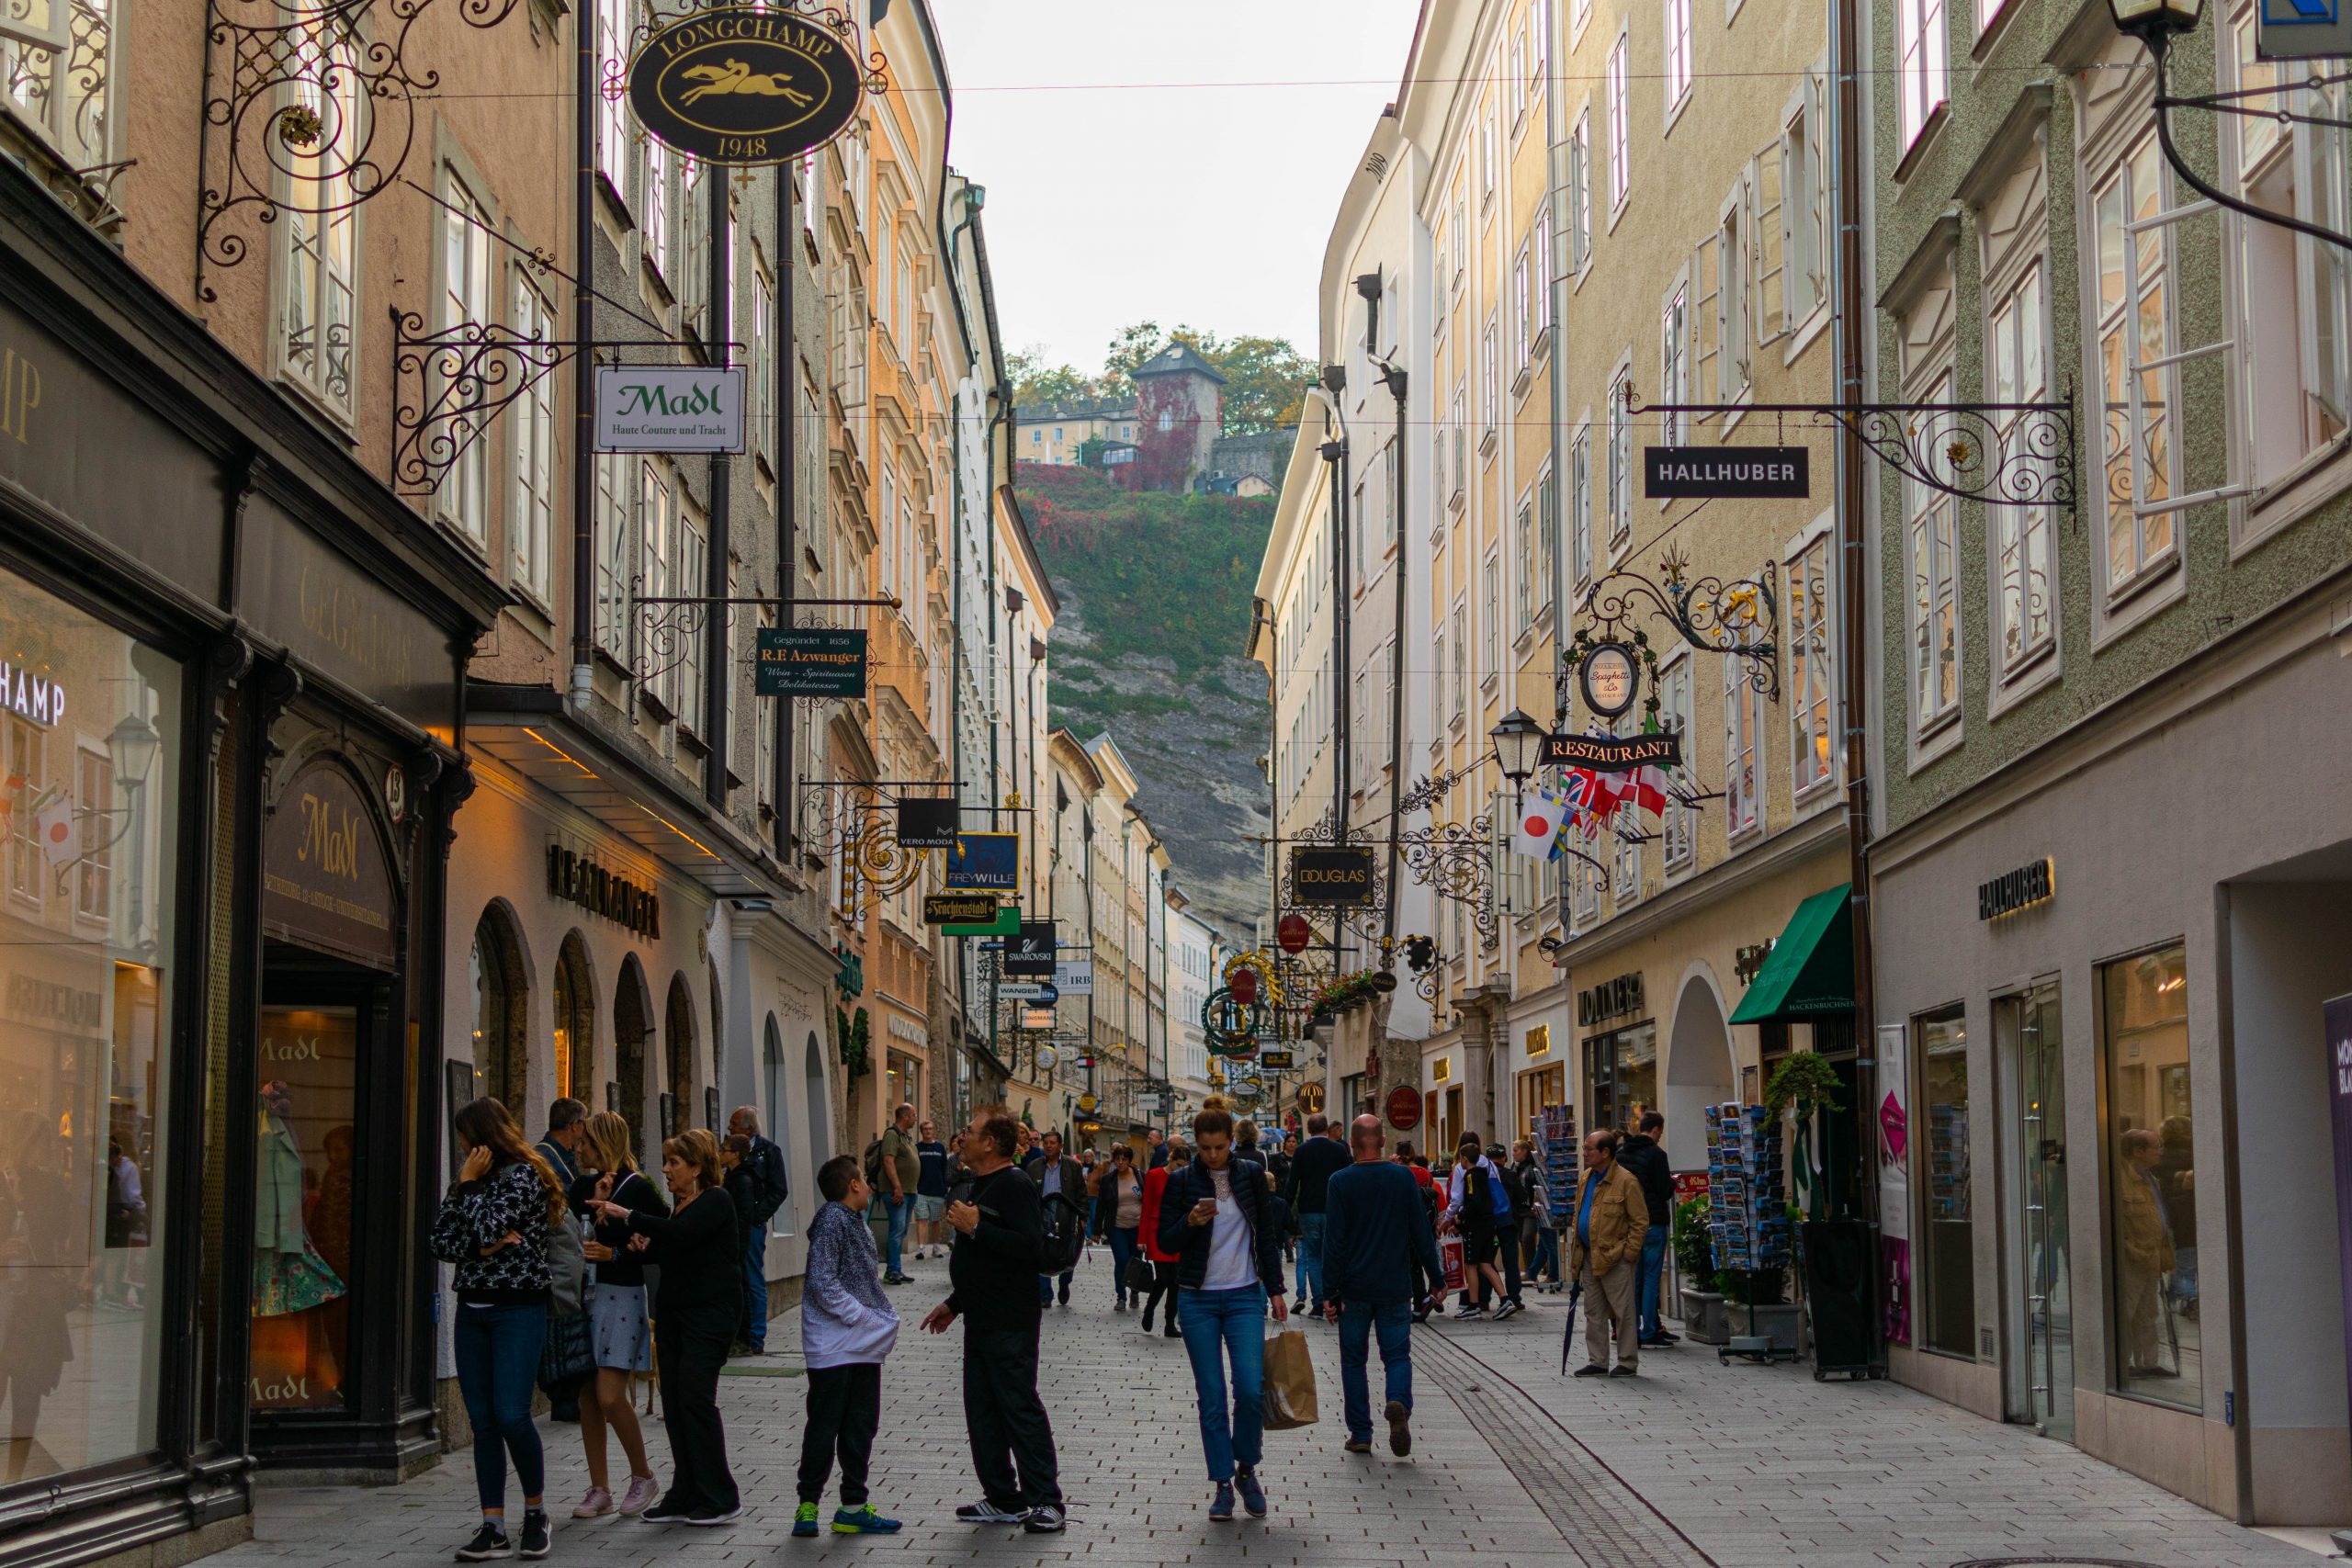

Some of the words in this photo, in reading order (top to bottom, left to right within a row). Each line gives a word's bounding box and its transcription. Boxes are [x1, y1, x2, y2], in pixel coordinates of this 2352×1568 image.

[660, 18, 832, 59] LONGCHAMP
[718, 138, 767, 157] 1948
[616, 380, 723, 416] Madl
[612, 424, 639, 434] Haute
[641, 424, 677, 434] Couture
[679, 424, 696, 434] und
[698, 424, 726, 434] Tracht
[1658, 463, 1796, 482] HALLHUBER
[774, 637, 820, 645] Gegründet
[829, 637, 850, 646] 1656
[790, 649, 860, 665] Azwanger
[764, 667, 791, 677] Wein
[802, 668, 857, 679] Spirituosen
[1590, 671, 1631, 683] Spaghetti
[777, 679, 841, 690] Delikatessen
[1551, 741, 1673, 762] RESTAURANT
[390, 770, 401, 802] 13
[297, 793, 360, 882] Madl
[948, 873, 1015, 884] FREYWILLE
[1300, 869, 1365, 884] DOUGLAS
[1978, 859, 2050, 920] HALLHUBER
[1008, 953, 1051, 962] SWAROVSKI
[1070, 976, 1091, 985] IRB
[1789, 1000, 1855, 1011] HACKENBUCHNER
